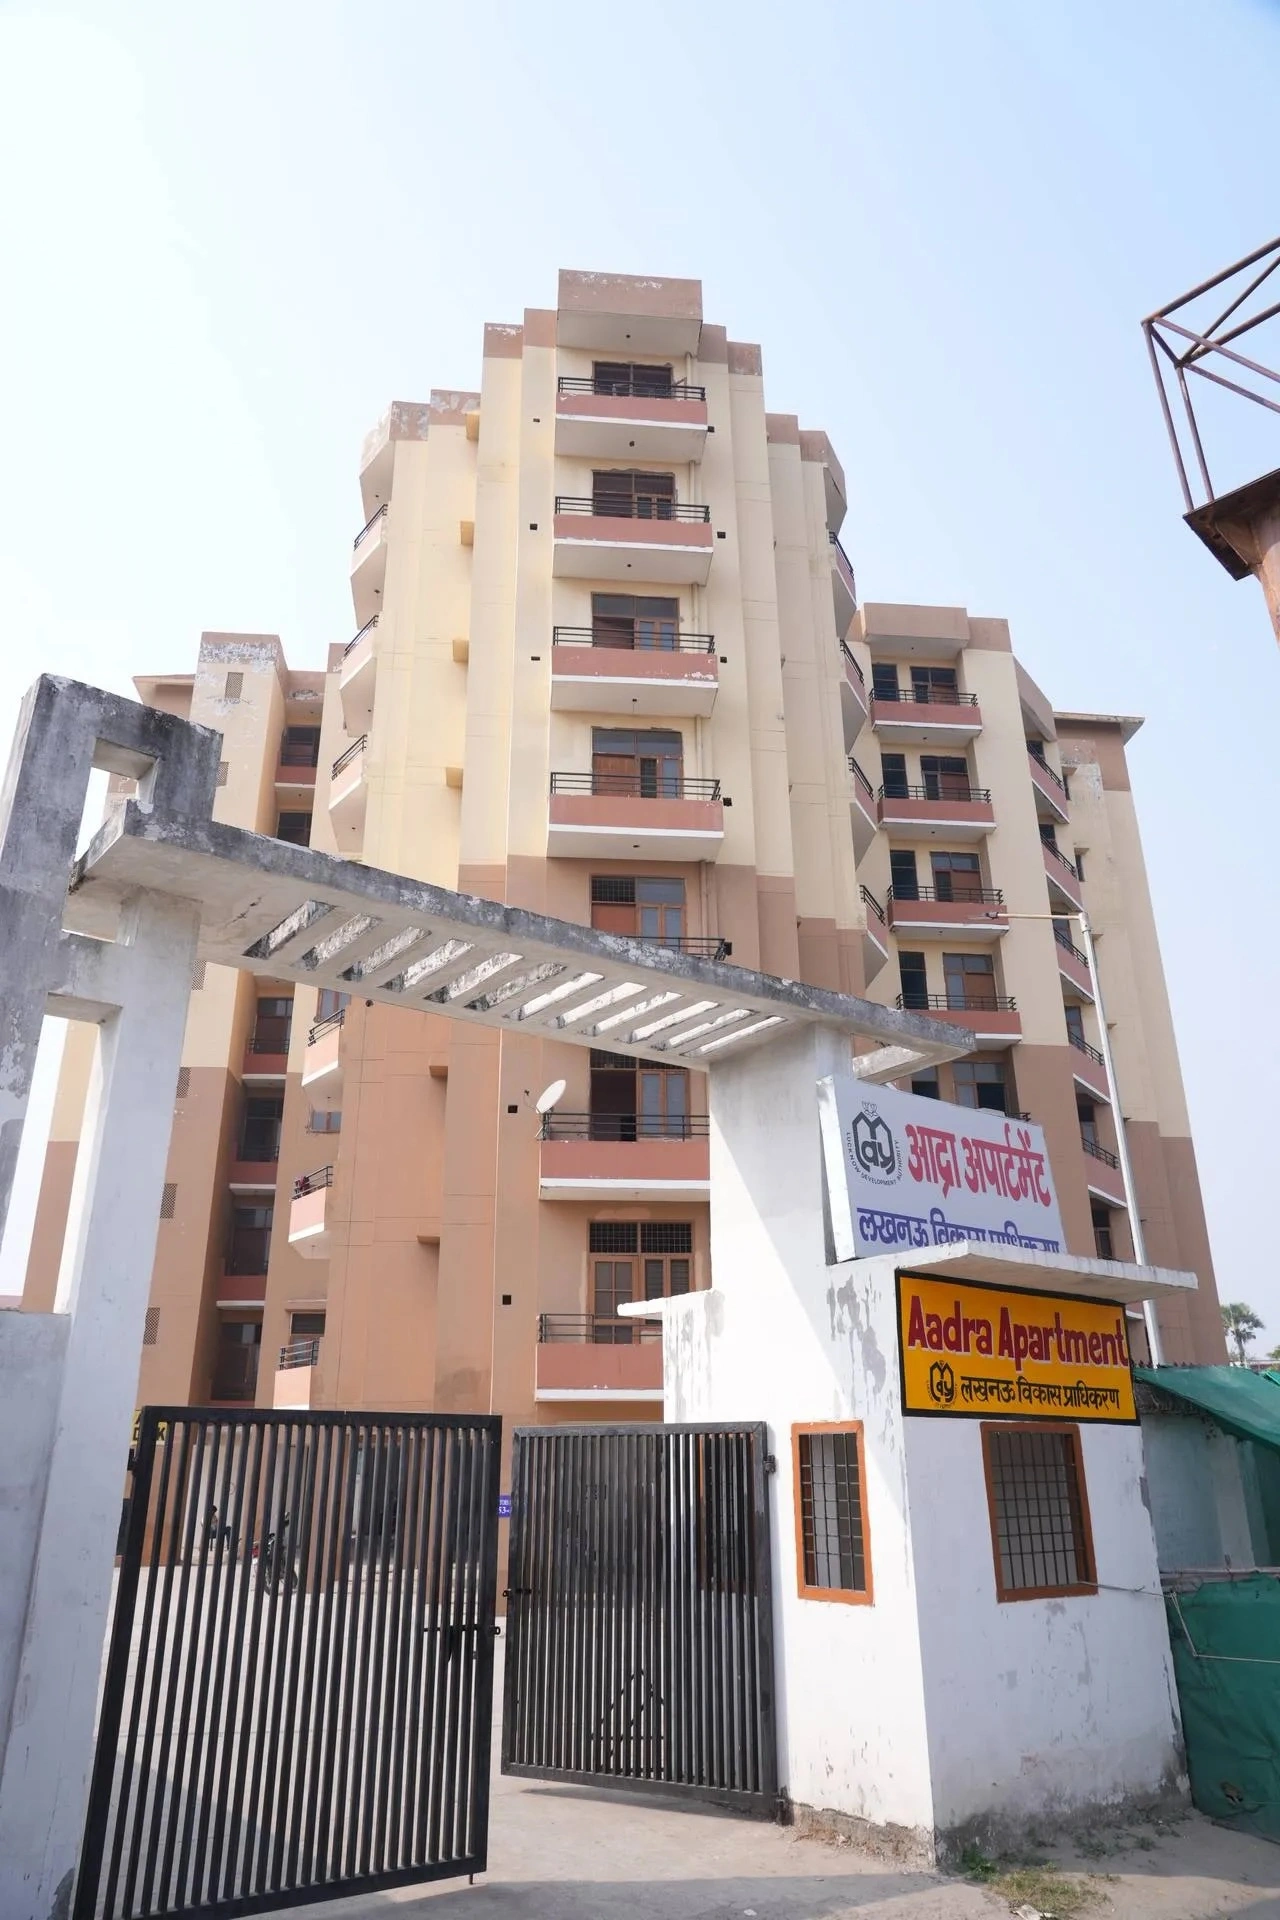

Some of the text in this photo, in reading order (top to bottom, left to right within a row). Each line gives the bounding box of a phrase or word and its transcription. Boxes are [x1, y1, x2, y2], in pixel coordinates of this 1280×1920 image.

[846, 1132, 861, 1173] LUCKNOW
[861, 1173, 897, 1186] DEVELOPMENT
[905, 1123, 1051, 1207] आद्रा अपार्टमेंट
[856, 1207, 930, 1247] लखनऊ
[908, 1295, 1129, 1371] Aadra Apartment
[960, 1375, 1015, 1403] लखनऊ
[1016, 1375, 1062, 1407] विकास
[1062, 1380, 1120, 1411] प्राधिकरण
